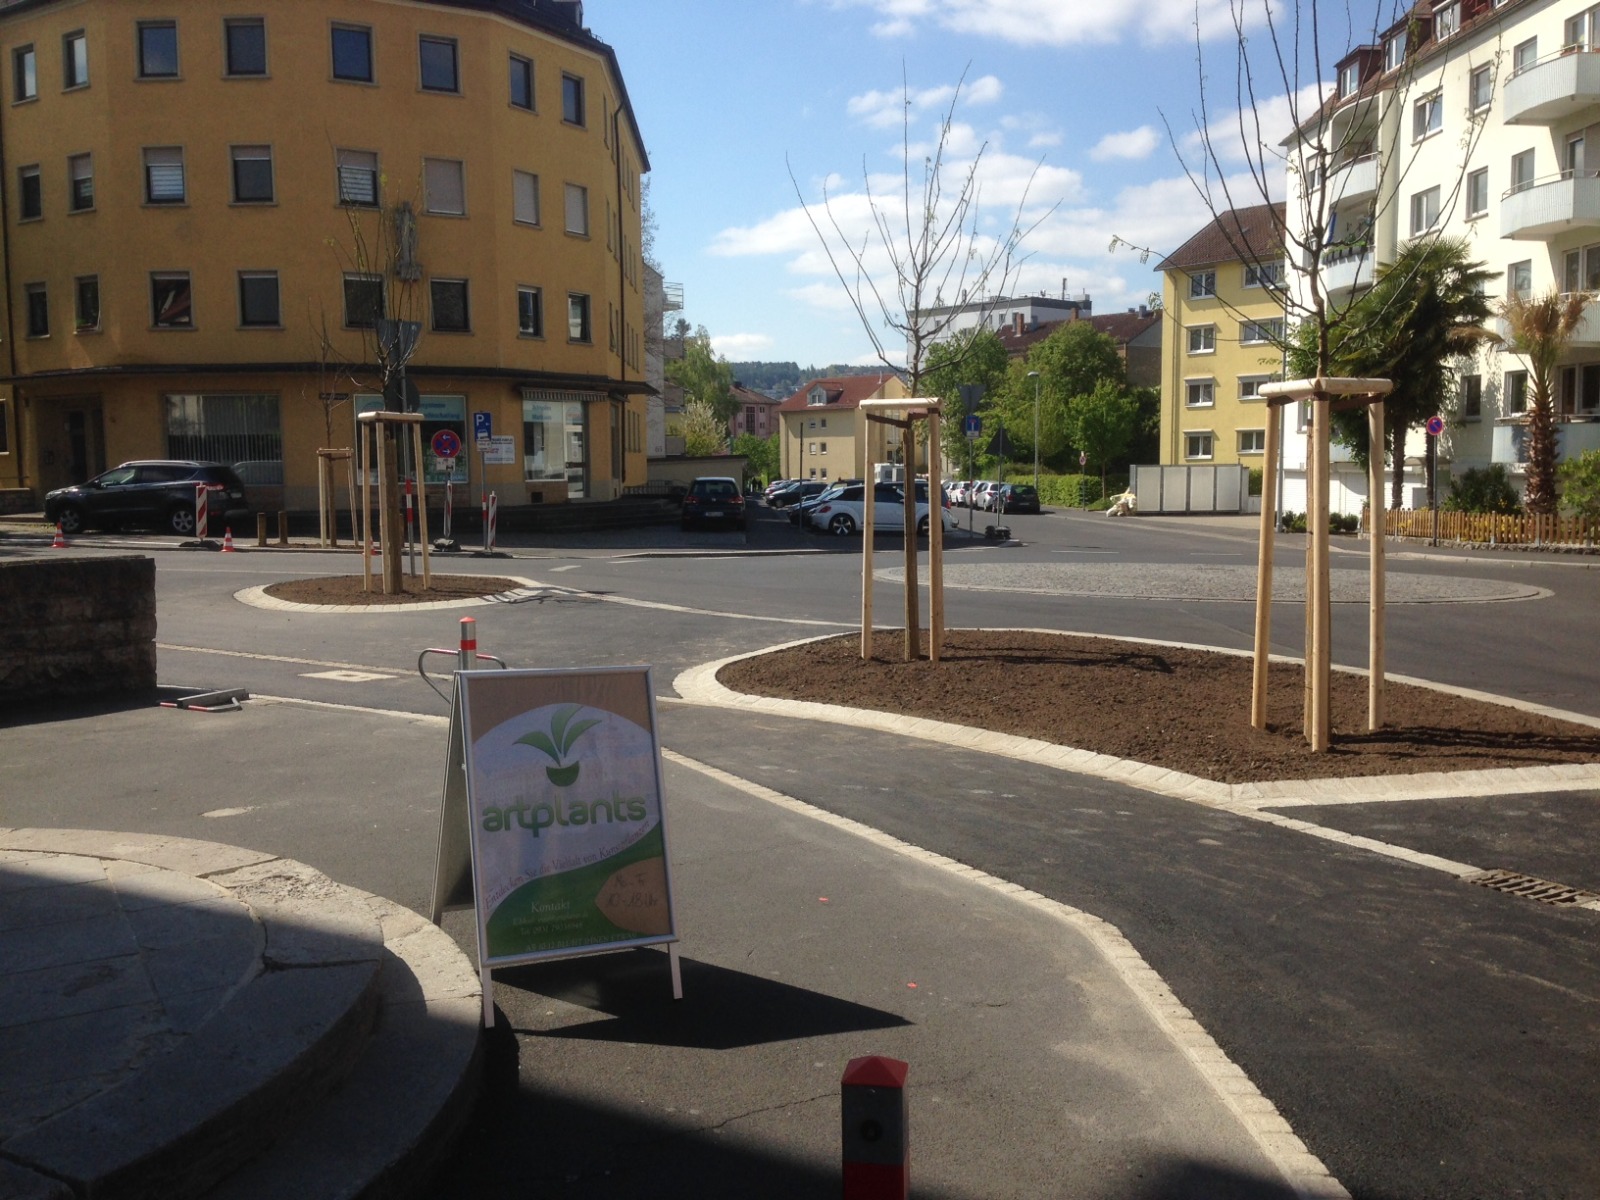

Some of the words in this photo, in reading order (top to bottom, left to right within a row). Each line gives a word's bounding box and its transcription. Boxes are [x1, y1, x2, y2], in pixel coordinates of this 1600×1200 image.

[476, 414, 485, 427] P
[482, 796, 647, 838] artplants
[484, 872, 525, 910] Entdecken
[525, 866, 538, 879] Sie
[539, 862, 551, 874] die
[552, 856, 581, 871] Vielfalt
[583, 852, 598, 865] von
[530, 899, 571, 913] Kontakt
